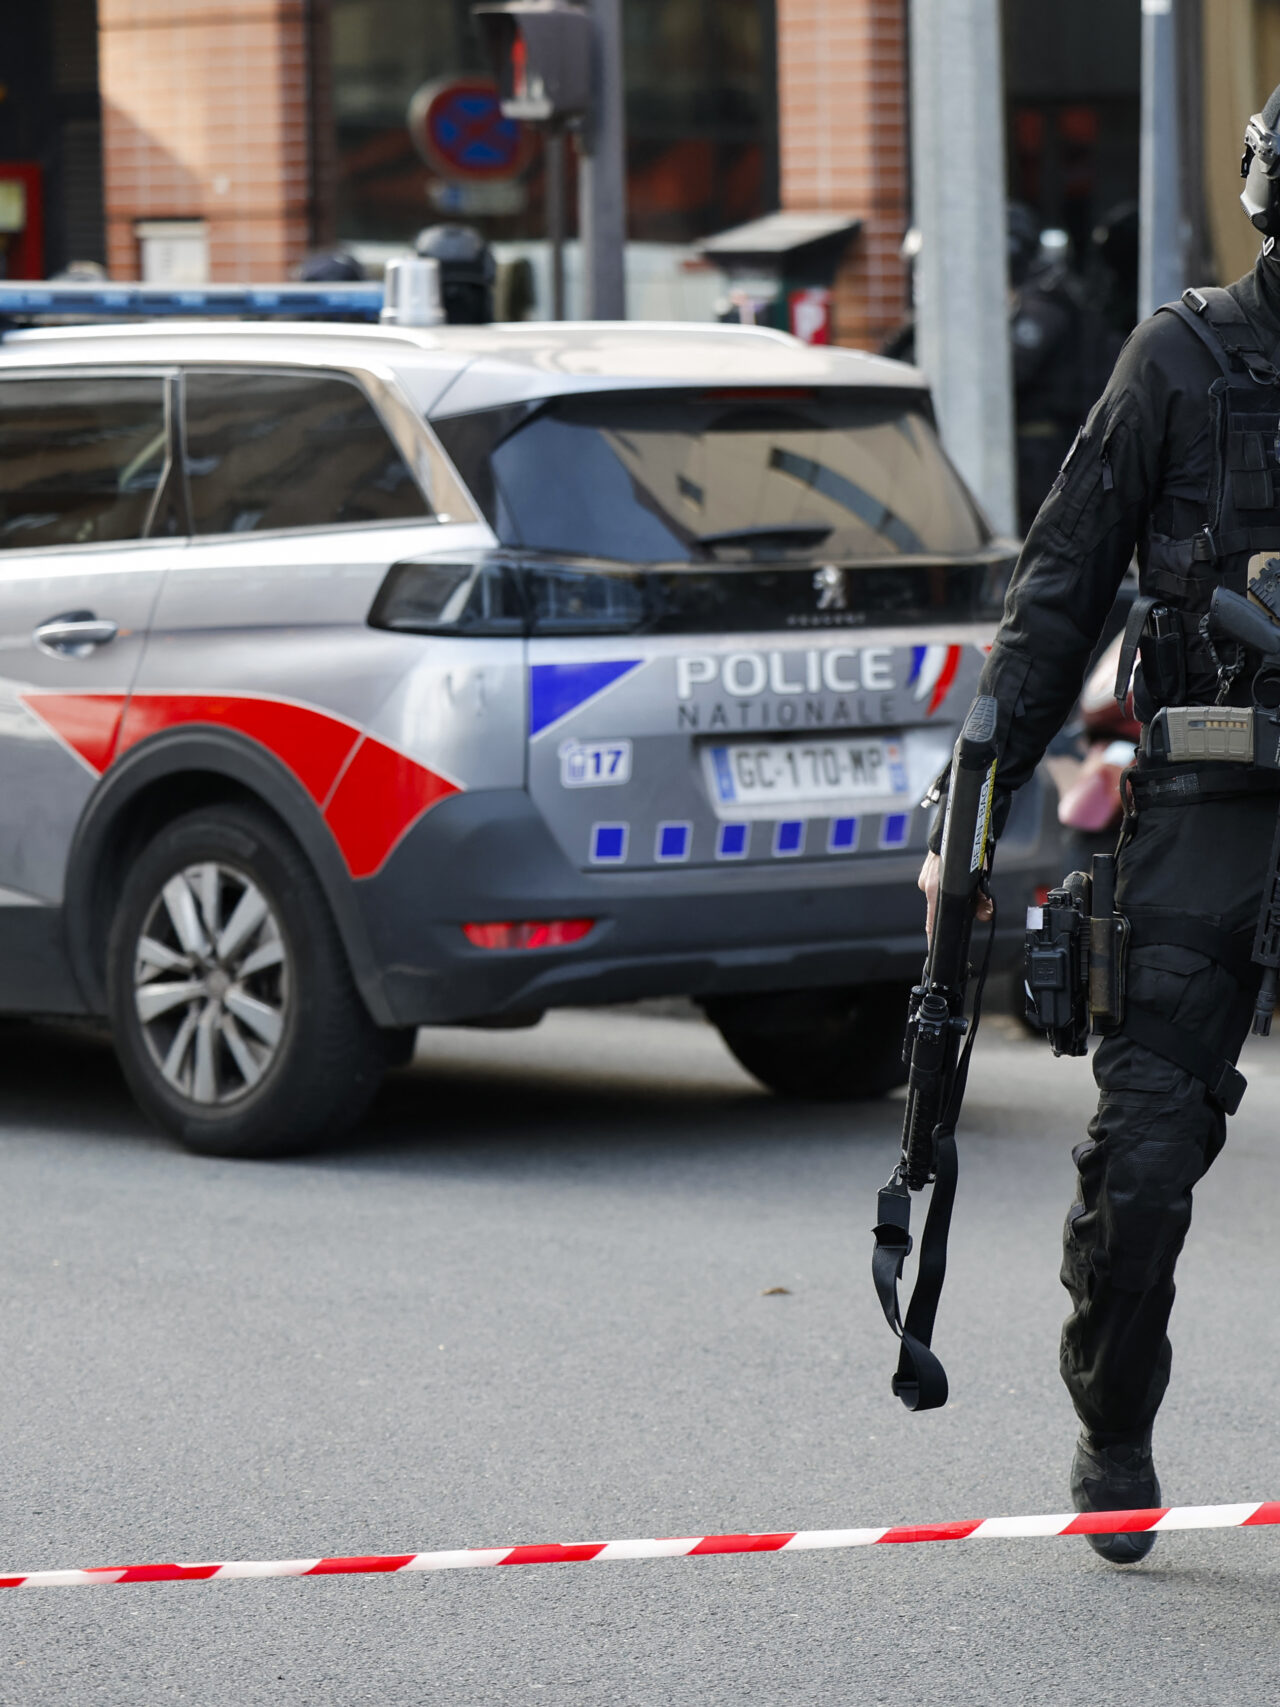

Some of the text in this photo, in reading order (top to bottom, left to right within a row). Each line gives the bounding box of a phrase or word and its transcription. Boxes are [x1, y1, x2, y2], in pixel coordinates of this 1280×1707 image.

[675, 647, 896, 700] POLICE
[677, 696, 896, 729] NATIONALE
[593, 750, 623, 775] 17
[971, 783, 990, 870] BEAN-BAG
